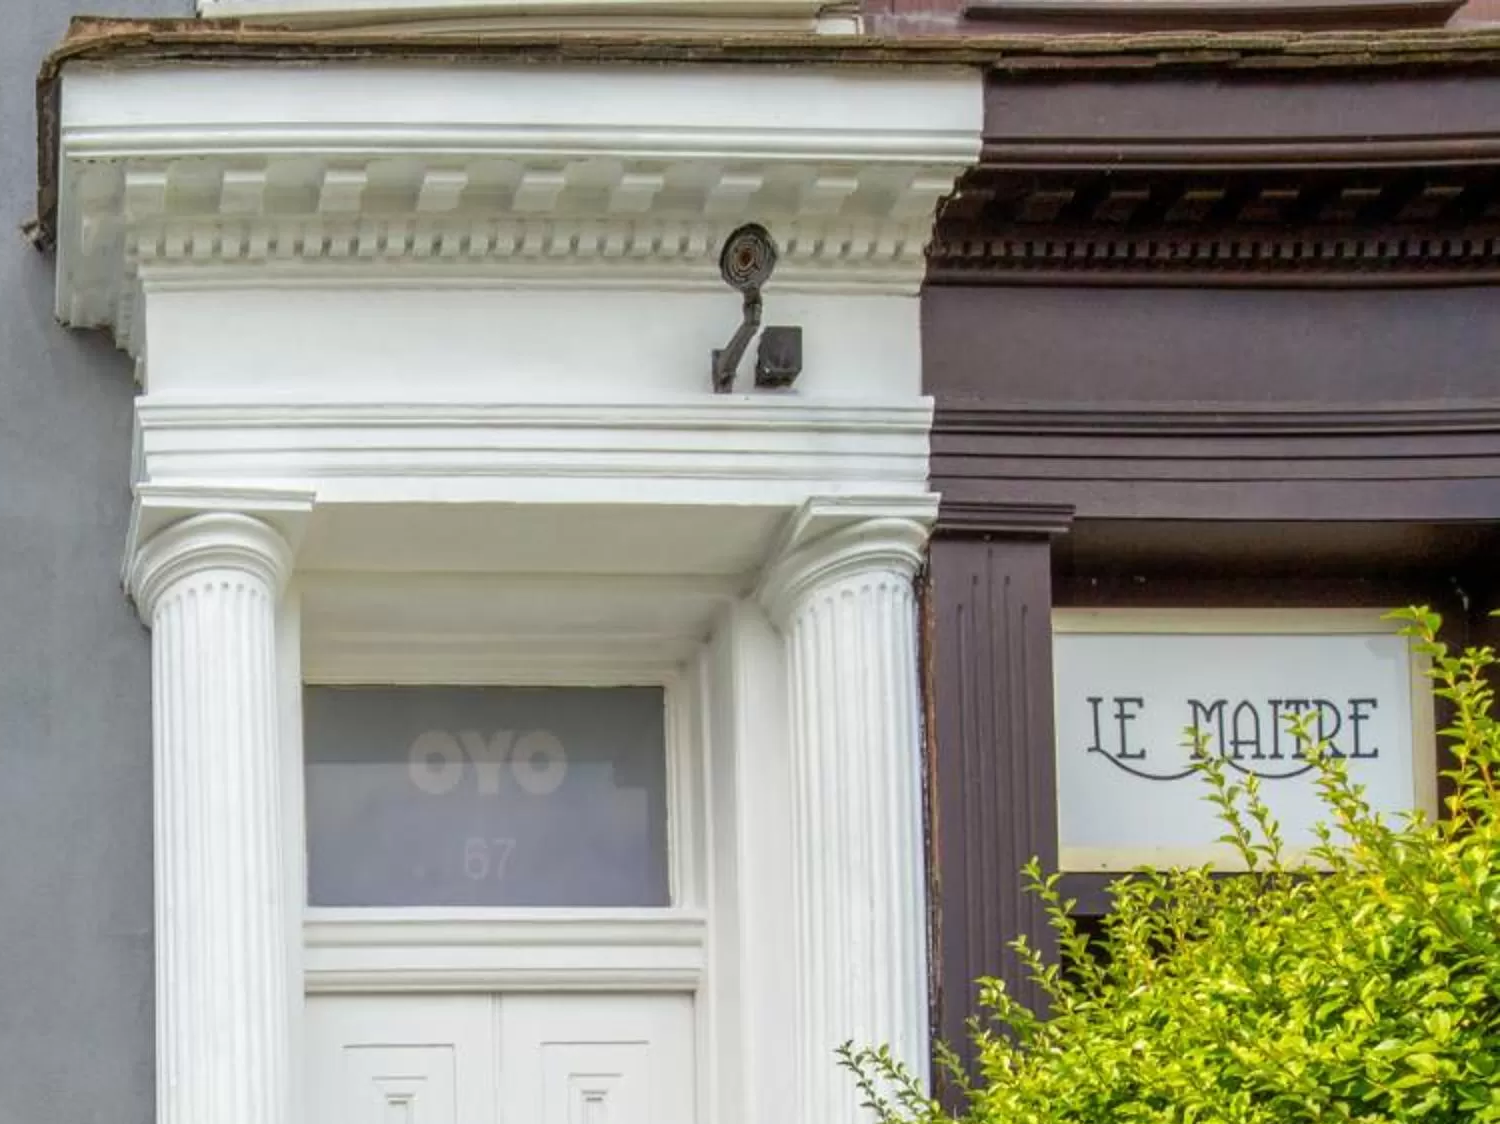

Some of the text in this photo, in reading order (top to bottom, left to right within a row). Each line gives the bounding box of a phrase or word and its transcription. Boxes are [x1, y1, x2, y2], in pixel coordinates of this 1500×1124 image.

[408, 729, 568, 795] OYO
[1086, 696, 1379, 769] LE MAITRE
[464, 837, 517, 880] 67
